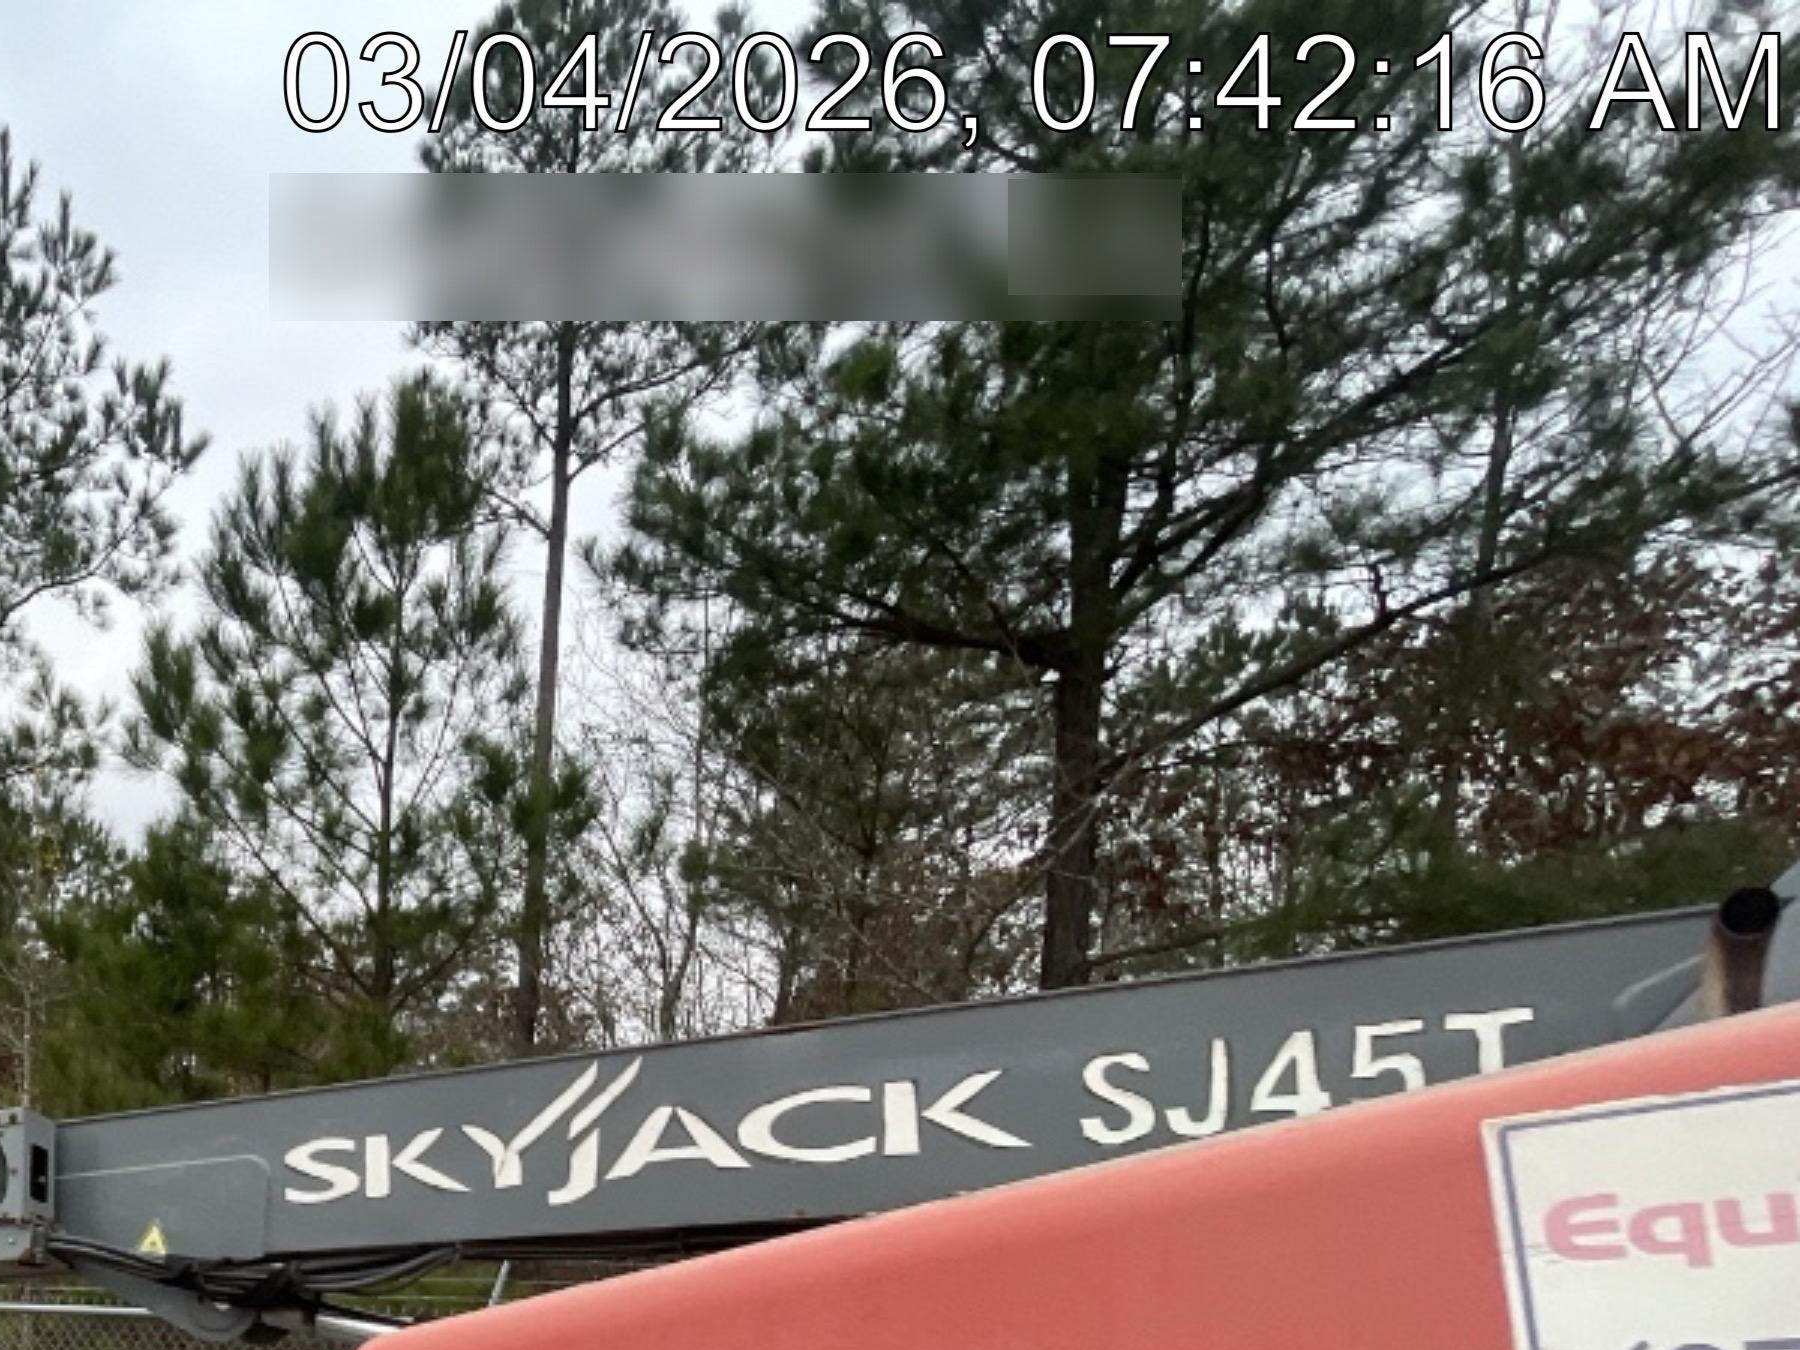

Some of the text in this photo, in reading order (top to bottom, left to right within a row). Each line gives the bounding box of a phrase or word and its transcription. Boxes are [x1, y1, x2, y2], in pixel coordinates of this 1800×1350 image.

[283, 1006, 1535, 1206] SKYJACK SJ45T
[1544, 1191, 1800, 1270] Equ
